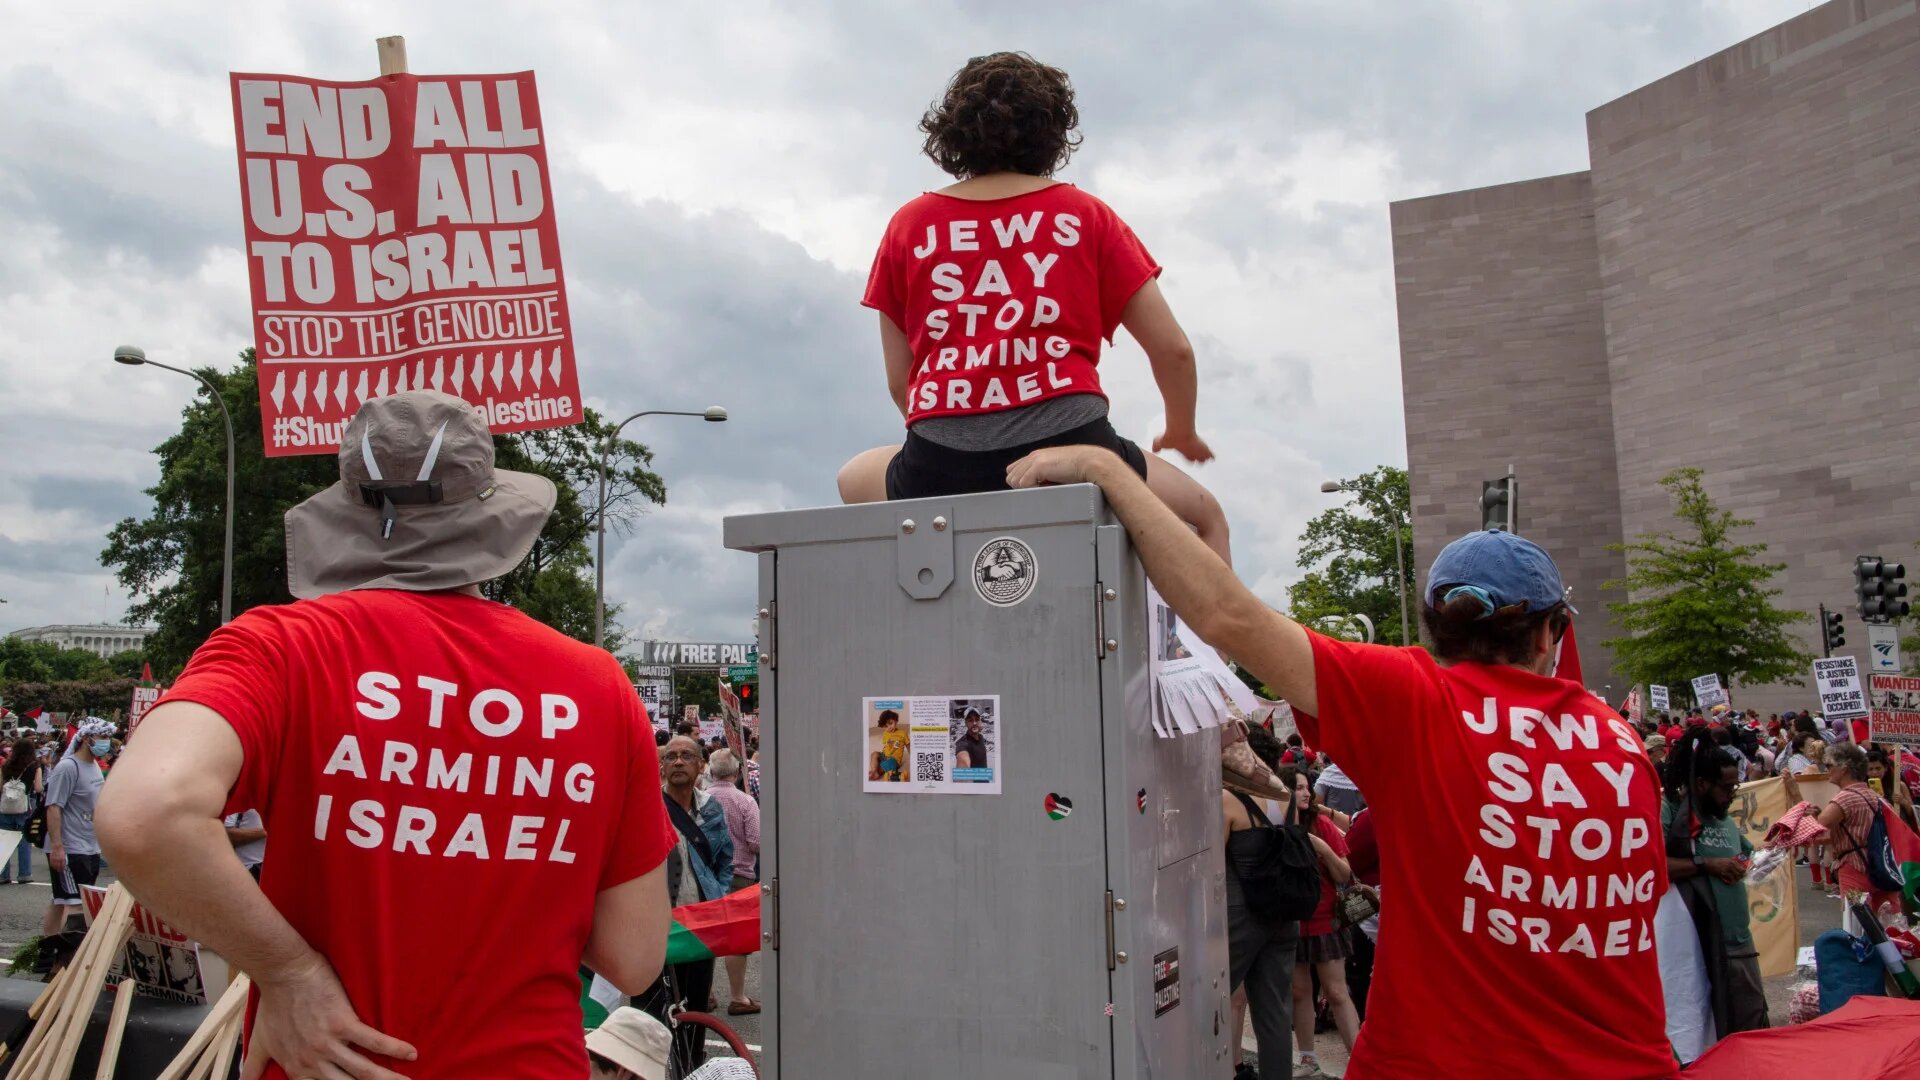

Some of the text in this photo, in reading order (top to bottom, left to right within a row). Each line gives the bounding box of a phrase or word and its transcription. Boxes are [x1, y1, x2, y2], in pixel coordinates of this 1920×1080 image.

[239, 80, 539, 159] END ALL
[246, 154, 544, 239] U.S. AID
[914, 211, 1081, 259] JEWS
[252, 228, 556, 304] TO ISRAEL
[931, 252, 1059, 302] SAY
[264, 295, 562, 356] STOP THE GENOCIDE
[926, 295, 1060, 341] STOP
[917, 335, 1070, 377] ARMING
[908, 362, 1072, 414] ISRAEL
[638, 666, 670, 676] WANTED
[681, 644, 716, 663] FREE
[721, 644, 759, 663] PAL
[1815, 659, 1854, 670] RESISTANCE
[1817, 669, 1856, 679] IS JUSTIFIED
[135, 688, 158, 701] END
[356, 671, 579, 739] STOP
[634, 686, 656, 697] REE
[1822, 691, 1862, 703] PEOPLE ARE
[1829, 678, 1849, 688] WHEN
[1872, 676, 1920, 690] WANTED
[1462, 697, 1642, 754] JEWS
[323, 734, 595, 804] ARMING
[1488, 752, 1635, 808] SAY
[314, 794, 576, 864] ISRAEL
[1479, 803, 1649, 861] STOP
[1698, 837, 1733, 848] LOCAL
[1464, 854, 1655, 910] ARMING
[1462, 896, 1652, 958] ISRAEL
[1155, 980, 1180, 1012] PALESTINE
